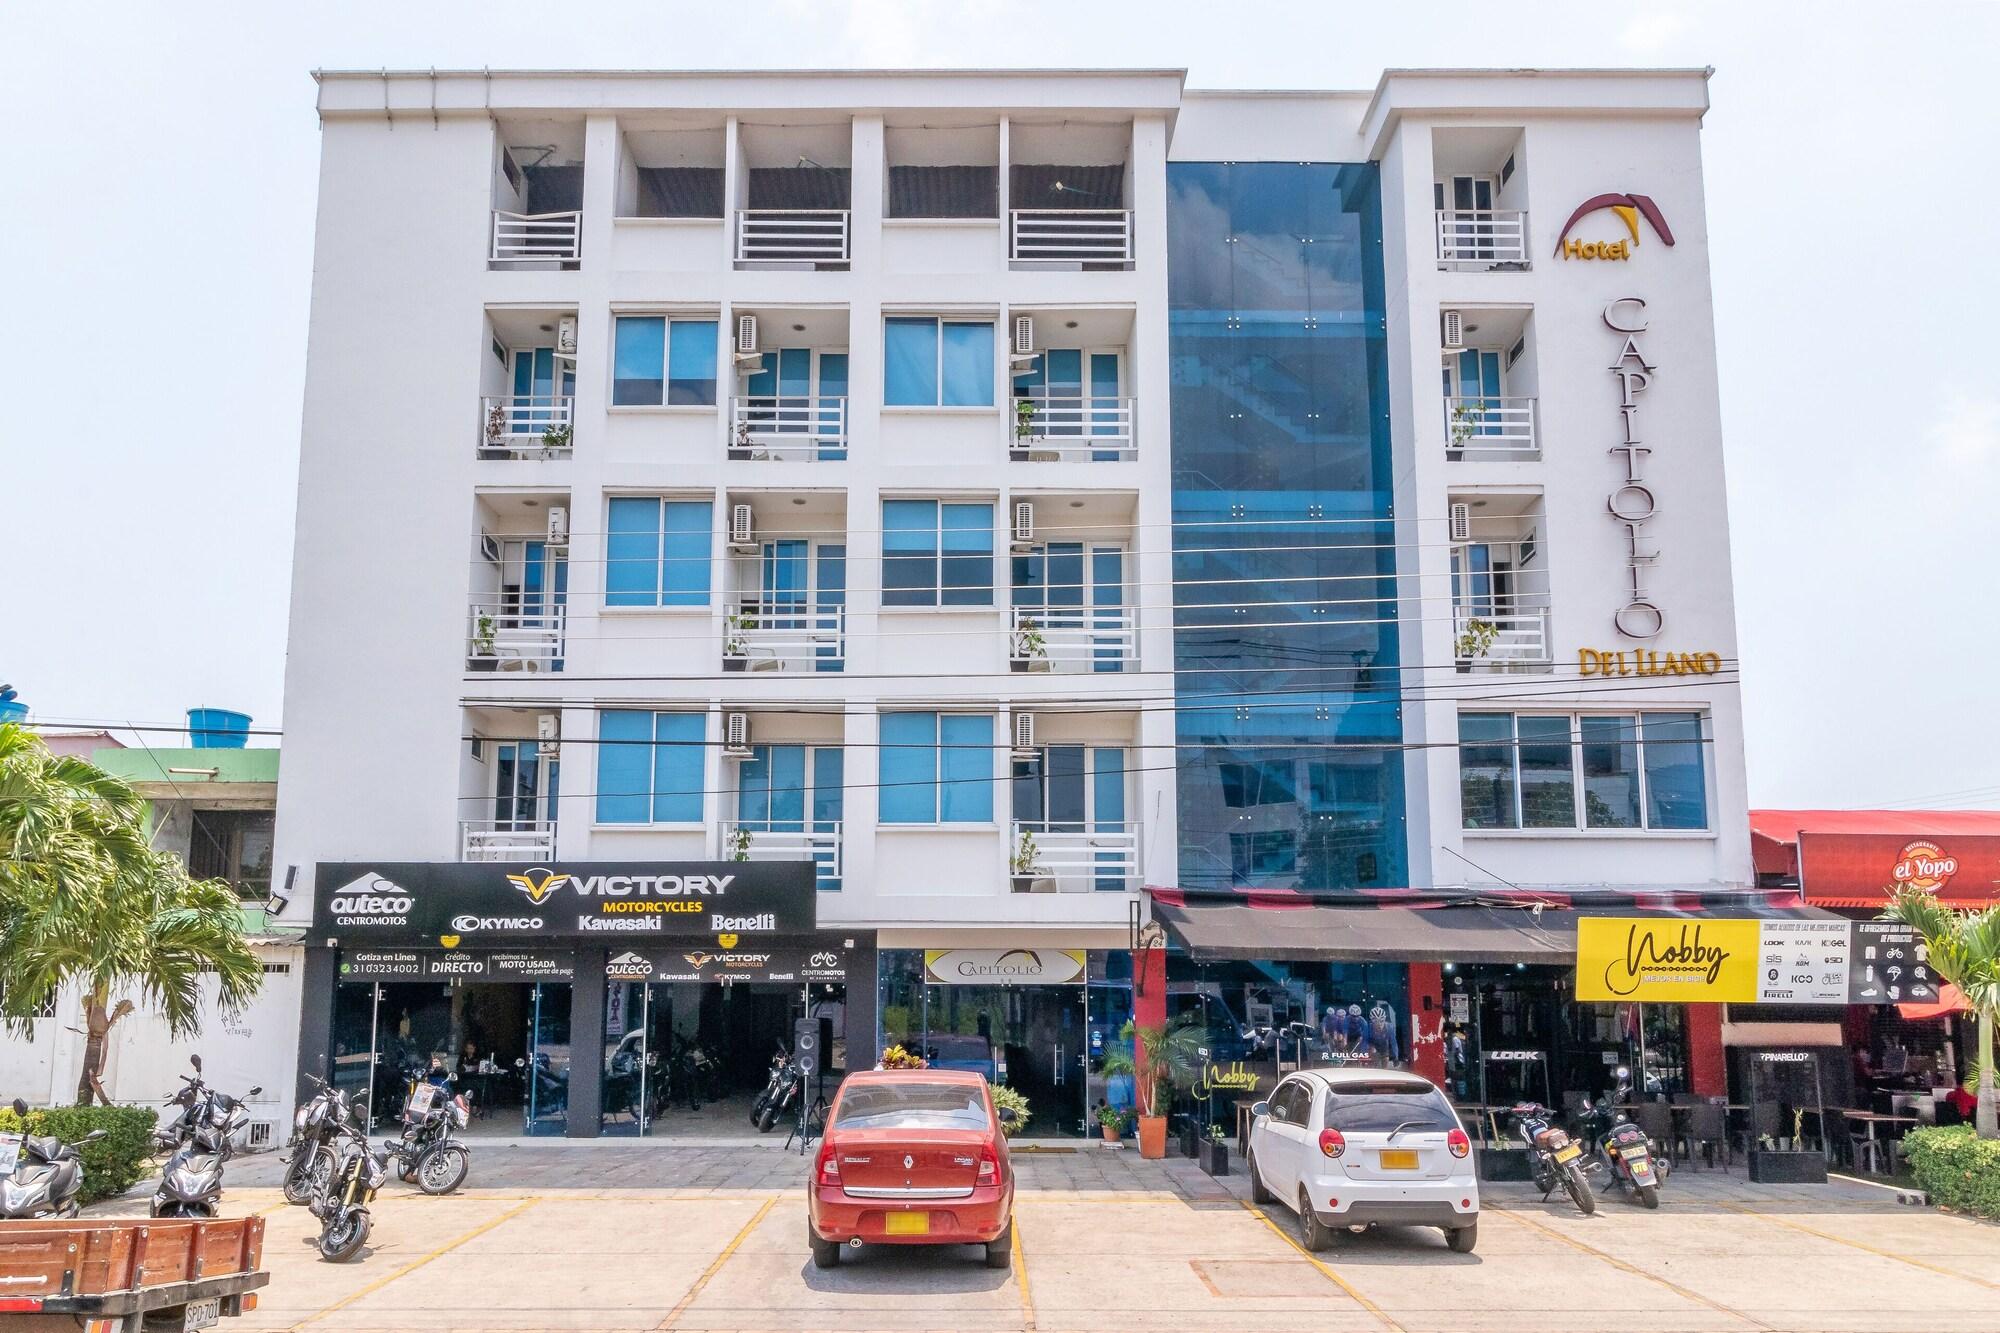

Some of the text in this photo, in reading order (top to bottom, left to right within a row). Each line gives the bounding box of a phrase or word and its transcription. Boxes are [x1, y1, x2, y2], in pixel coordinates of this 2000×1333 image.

[1563, 239, 1630, 261] Hotel
[1602, 297, 1664, 639] CAPITOLIO
[1578, 647, 1721, 676] DEL LLANO
[1895, 858, 1955, 878] el Yopo
[570, 875, 735, 896] VICTORY
[330, 894, 412, 914] auteco
[603, 901, 703, 913] MOTORCYCLES
[337, 916, 407, 926] CENTROMOTOS
[480, 917, 544, 930] KYMCO
[578, 915, 662, 931] Kawasaki
[711, 913, 776, 931] Benelli
[356, 953, 381, 961] Cotiza
[713, 954, 771, 963] VICTORY
[1627, 924, 1730, 985] Nobby
[352, 964, 419, 973] 3103234002
[431, 962, 483, 973] DIRECTO
[499, 961, 556, 969] MOTO USADA
[606, 964, 653, 975] auteco
[957, 961, 1043, 977] CAPITOLIO
[1764, 990, 1793, 999] PIRELLI
[1491, 1051, 1539, 1060] LOOK
